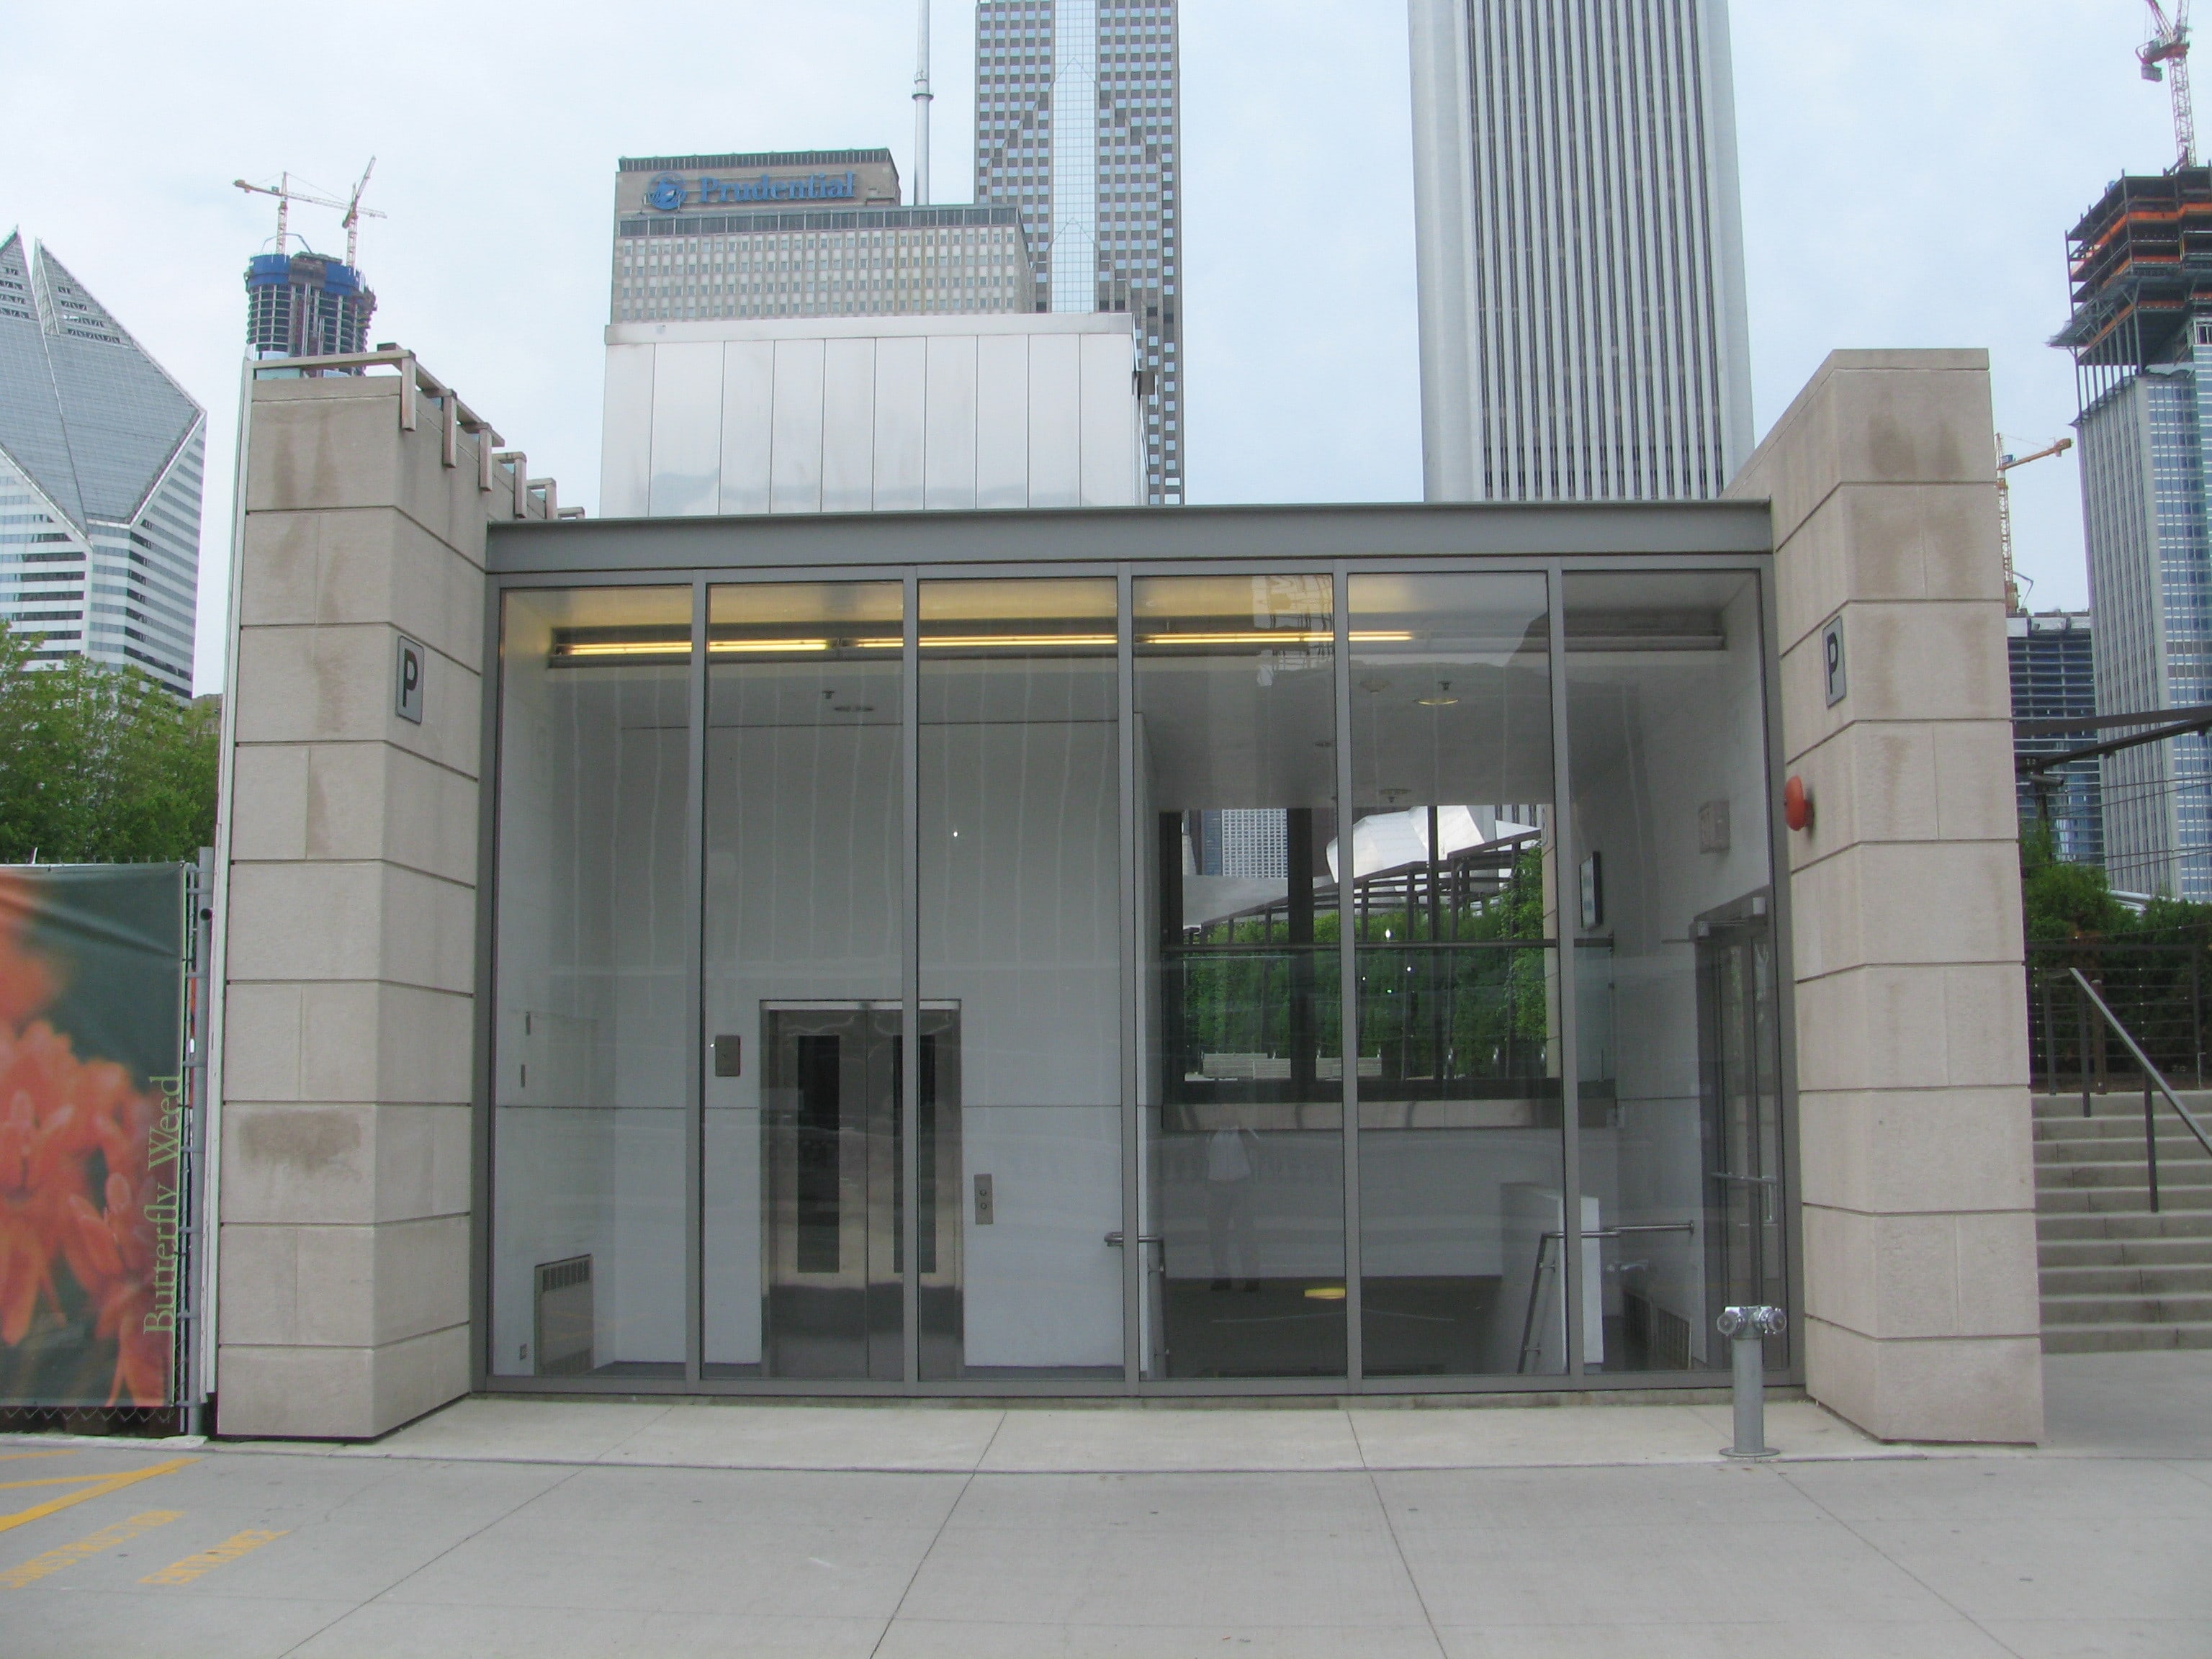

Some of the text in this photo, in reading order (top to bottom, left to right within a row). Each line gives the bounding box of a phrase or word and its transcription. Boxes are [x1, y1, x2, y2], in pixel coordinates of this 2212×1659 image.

[698, 172, 855, 203] Prudential
[403, 648, 418, 707] P
[1827, 632, 1838, 695] P
[144, 1076, 180, 1334] Butterfly Weed
